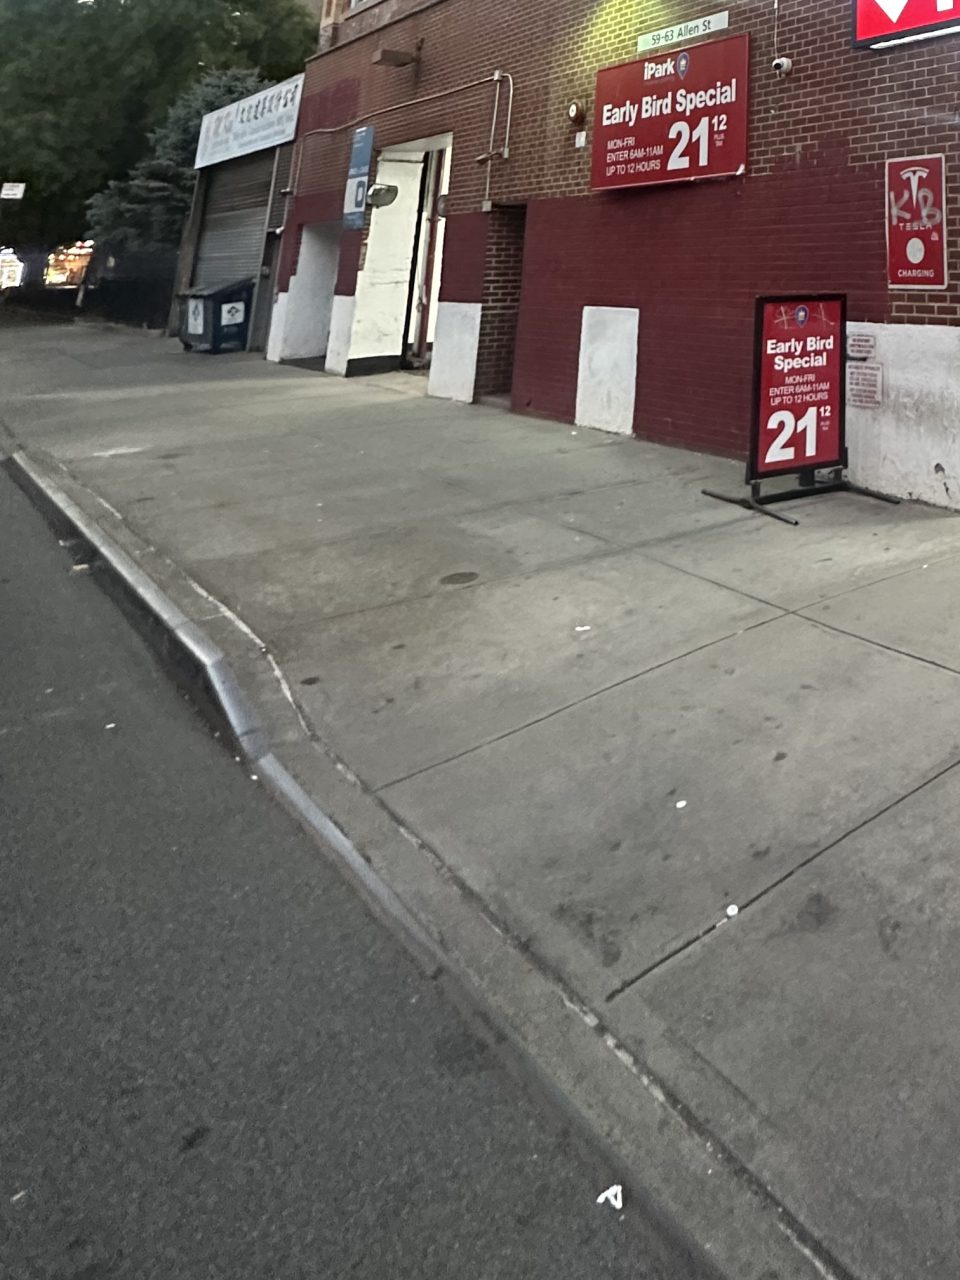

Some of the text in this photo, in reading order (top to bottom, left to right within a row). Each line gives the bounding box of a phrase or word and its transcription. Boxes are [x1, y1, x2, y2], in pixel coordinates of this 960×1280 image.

[651, 19, 711, 46] 59-63 Allen St
[643, 58, 676, 81] iPark
[602, 78, 737, 127] Early Bird Special
[607, 136, 636, 150] MON-FRI
[666, 114, 728, 171] 21 12
[606, 145, 664, 163] ENTER 6AM-11AM
[606, 159, 661, 177] UP TO 12 HOURS
[897, 268, 935, 278] CHARGING
[766, 337, 804, 356] Early
[806, 335, 834, 352] Bird
[773, 351, 827, 373] Special
[784, 373, 815, 385] MON-FRI
[769, 381, 830, 397] ENTER 6AM-11AM
[770, 391, 829, 406] UP TO 12 HOURS
[764, 405, 831, 464] 21 12
